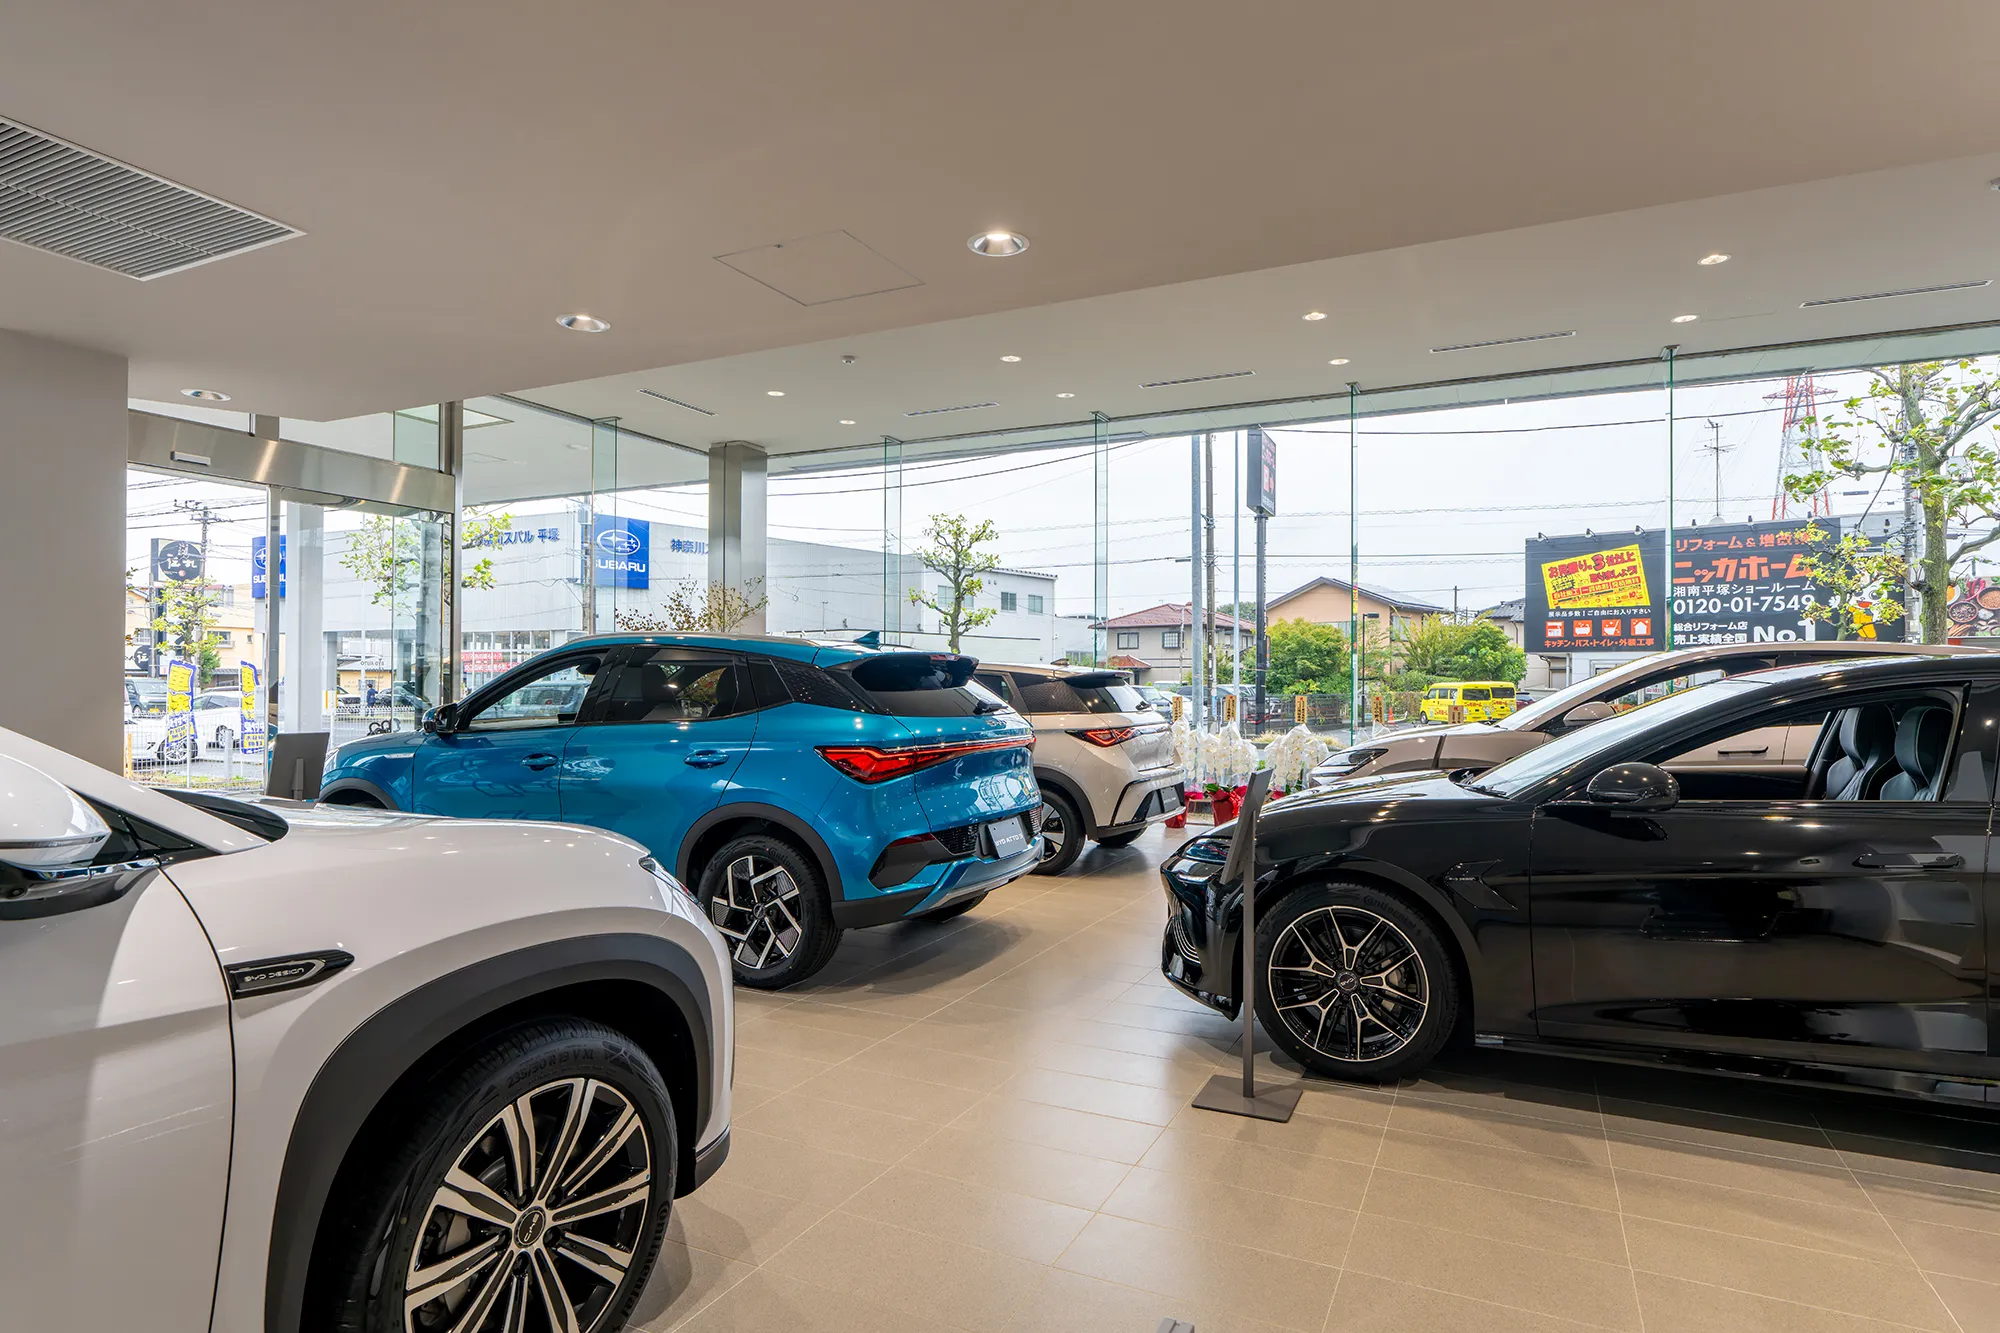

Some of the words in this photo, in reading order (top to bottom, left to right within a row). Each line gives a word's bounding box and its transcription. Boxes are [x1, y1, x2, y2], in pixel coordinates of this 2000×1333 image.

[671, 538, 709, 555] 神奈川
[1675, 536, 1743, 552] リフォーム
[1745, 537, 1756, 547] &
[1672, 554, 1813, 584] ニッカホーム
[1673, 581, 1816, 598] 湘南平塚ショールーム
[1673, 594, 1816, 615] 0120-01-7549
[1673, 621, 1748, 632] 総合リフォーム店
[1673, 633, 1748, 645] 売上実績全国
[1753, 617, 1816, 642] No.1
[244, 974, 266, 982] BYD
[268, 967, 305, 979] DESIGN
